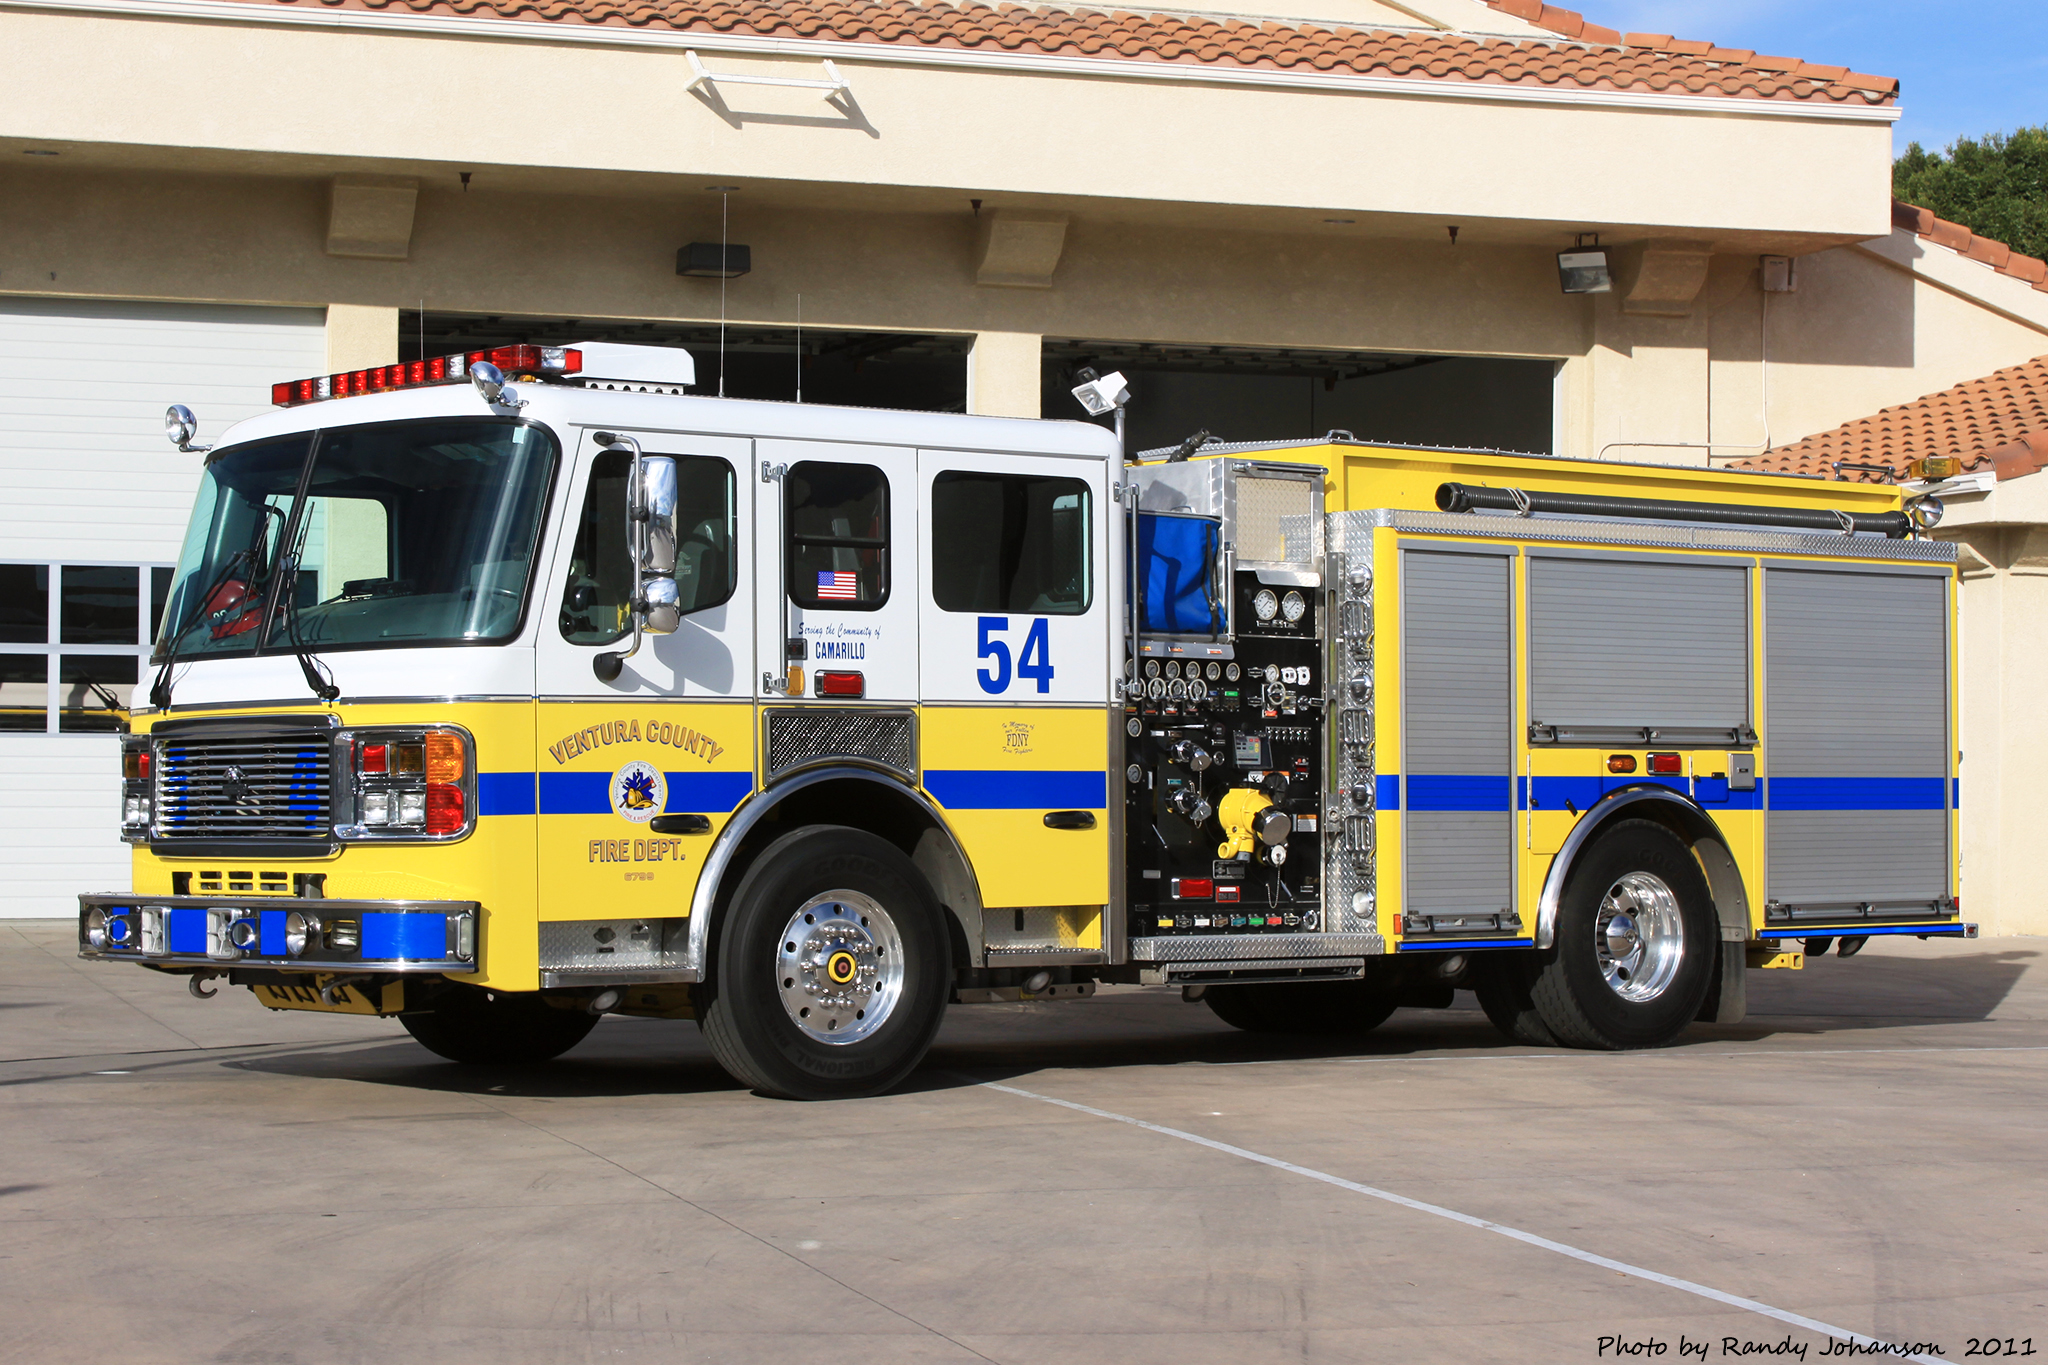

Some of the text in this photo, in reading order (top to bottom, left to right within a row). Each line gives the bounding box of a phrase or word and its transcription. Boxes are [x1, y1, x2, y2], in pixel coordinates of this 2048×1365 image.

[798, 621, 882, 640] Serving the Community of
[815, 641, 865, 660] CAMARILLO
[976, 616, 1054, 695] 54
[548, 719, 724, 765] VENTURA COUNTY
[1006, 733, 1028, 746] FDNY
[614, 777, 622, 800] Ventura
[619, 763, 637, 777] County
[648, 765, 662, 799] Department
[623, 810, 633, 819] FIRE
[637, 809, 655, 821] RESCUE
[589, 837, 687, 863] FIRE DEPT.
